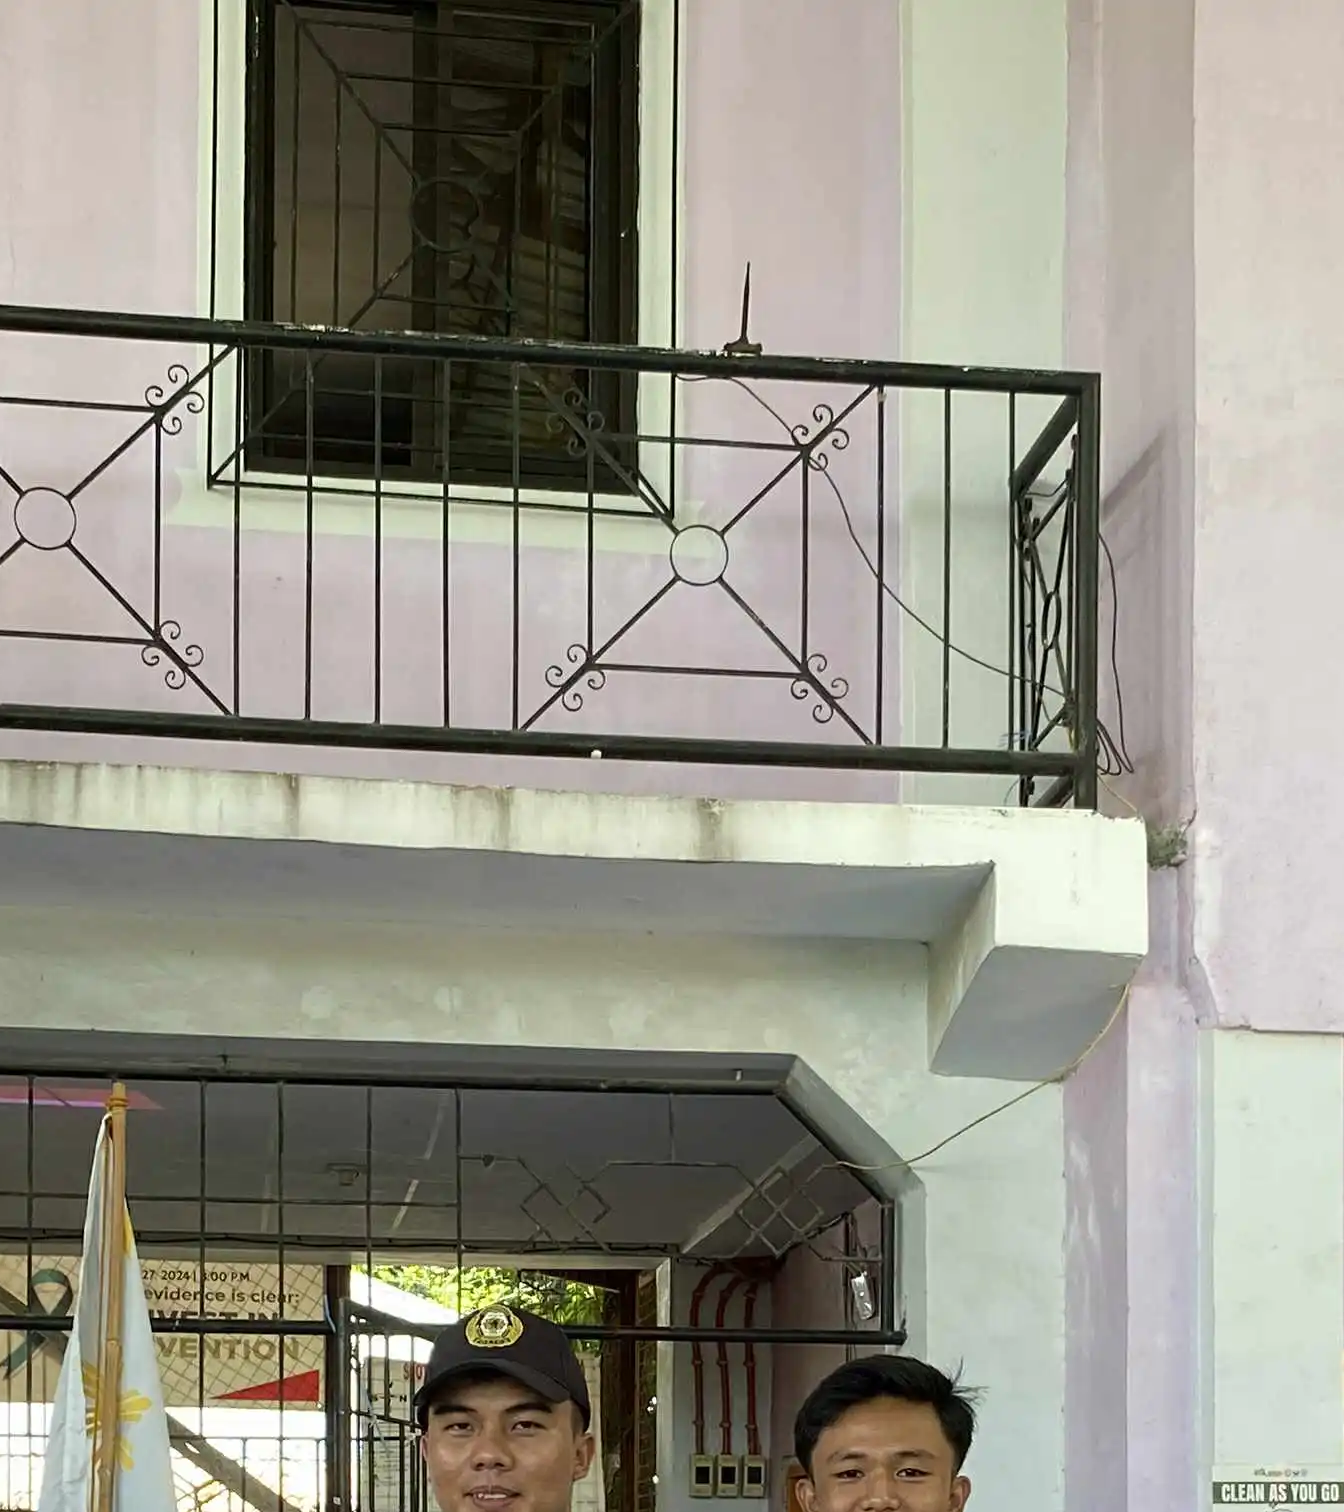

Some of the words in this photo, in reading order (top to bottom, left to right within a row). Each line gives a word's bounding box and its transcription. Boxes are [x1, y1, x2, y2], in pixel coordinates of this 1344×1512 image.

[144, 1286, 226, 1302] evidence
[231, 1289, 247, 1303] is
[250, 1290, 300, 1304] clear:
[1221, 1483, 1266, 1502] CLEAN
[1269, 1483, 1288, 1502] AS
[1290, 1483, 1318, 1502] YOU
[1321, 1483, 1340, 1502] GO
